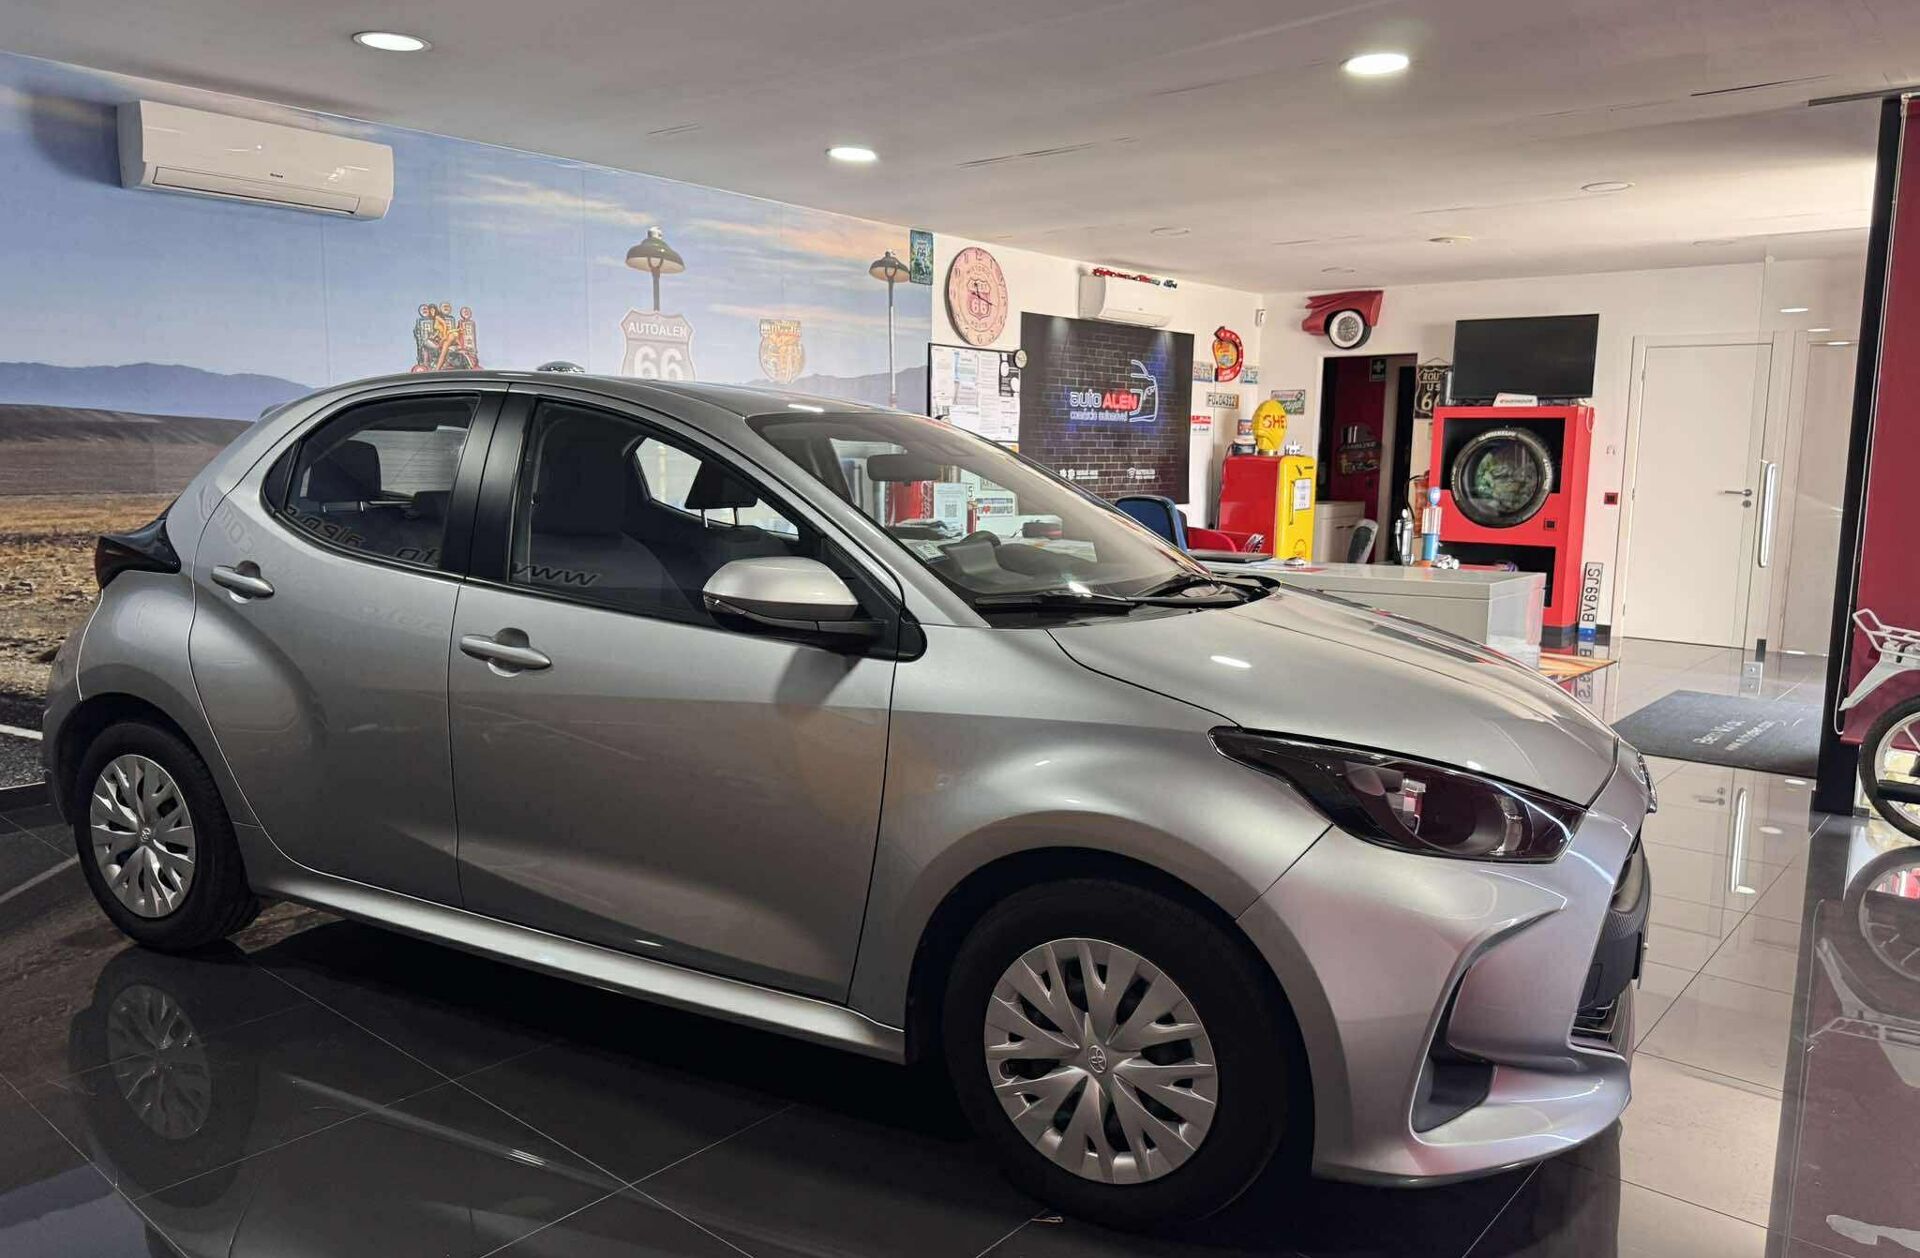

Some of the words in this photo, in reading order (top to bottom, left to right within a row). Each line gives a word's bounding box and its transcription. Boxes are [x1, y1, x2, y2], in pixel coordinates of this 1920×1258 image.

[628, 322, 687, 337] AUTOALEN
[634, 345, 684, 379] 66
[1070, 389, 1102, 408] auto
[1103, 392, 1138, 410] ALEN
